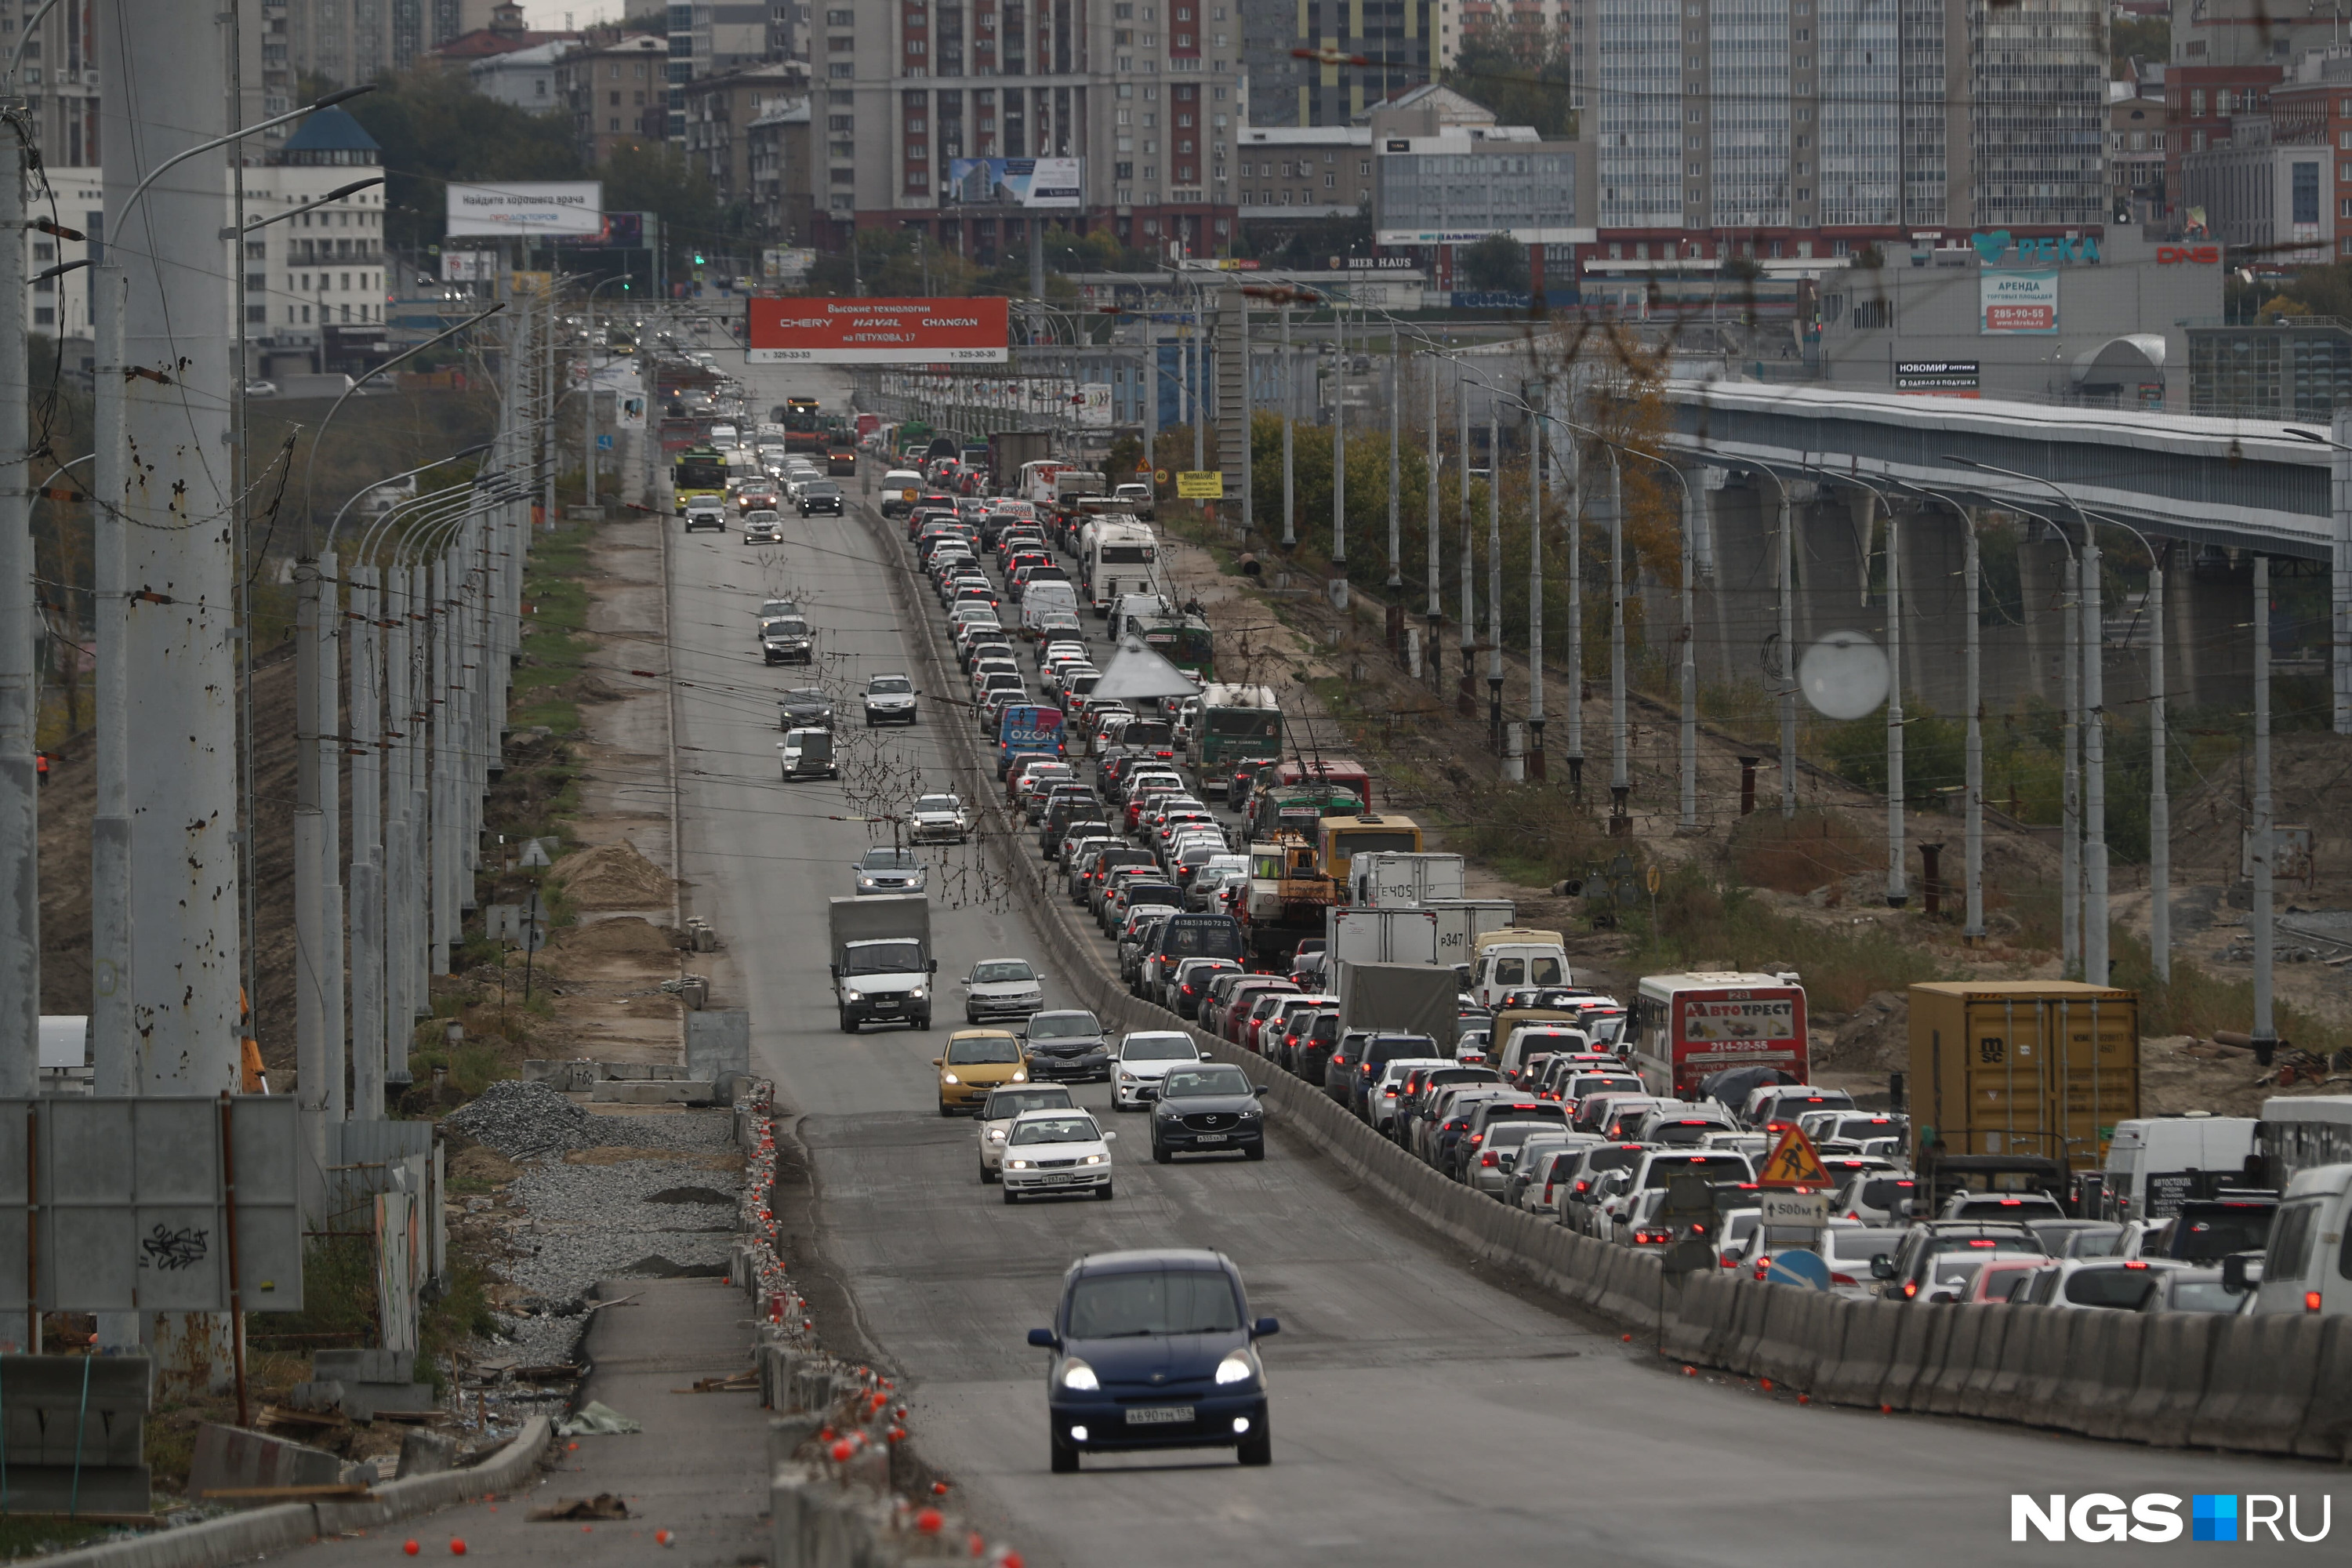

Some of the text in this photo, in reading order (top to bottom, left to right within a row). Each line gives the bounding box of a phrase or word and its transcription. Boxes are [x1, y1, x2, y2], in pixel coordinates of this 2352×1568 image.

[463, 195, 585, 207] Найдите хорошего врача
[2018, 238, 2100, 261] РЕКА
[2156, 246, 2219, 263] DNS
[1348, 258, 1412, 268] BIER HAUS
[1998, 281, 2040, 292] АРЕНДА
[827, 303, 931, 314] Высокие технологии
[1994, 308, 2045, 318] 285-90-55
[780, 318, 833, 328] CHERY
[852, 318, 902, 327] HAVAL
[921, 318, 978, 327] CHANGAN
[855, 332, 904, 343] ПЕТУХОВА,
[906, 332, 916, 342] 17
[1899, 364, 1947, 372] НОВОМИР
[1183, 472, 1216, 481] ВНИМАНИЕ!
[1011, 730, 1057, 741] OZON
[1731, 991, 1748, 1000] 28
[1686, 1003, 1792, 1018] АВТОТРЕСТ
[2154, 1178, 2192, 1187] АВТОСТЕКЛА
[1130, 1410, 1174, 1422] А690ТМ
